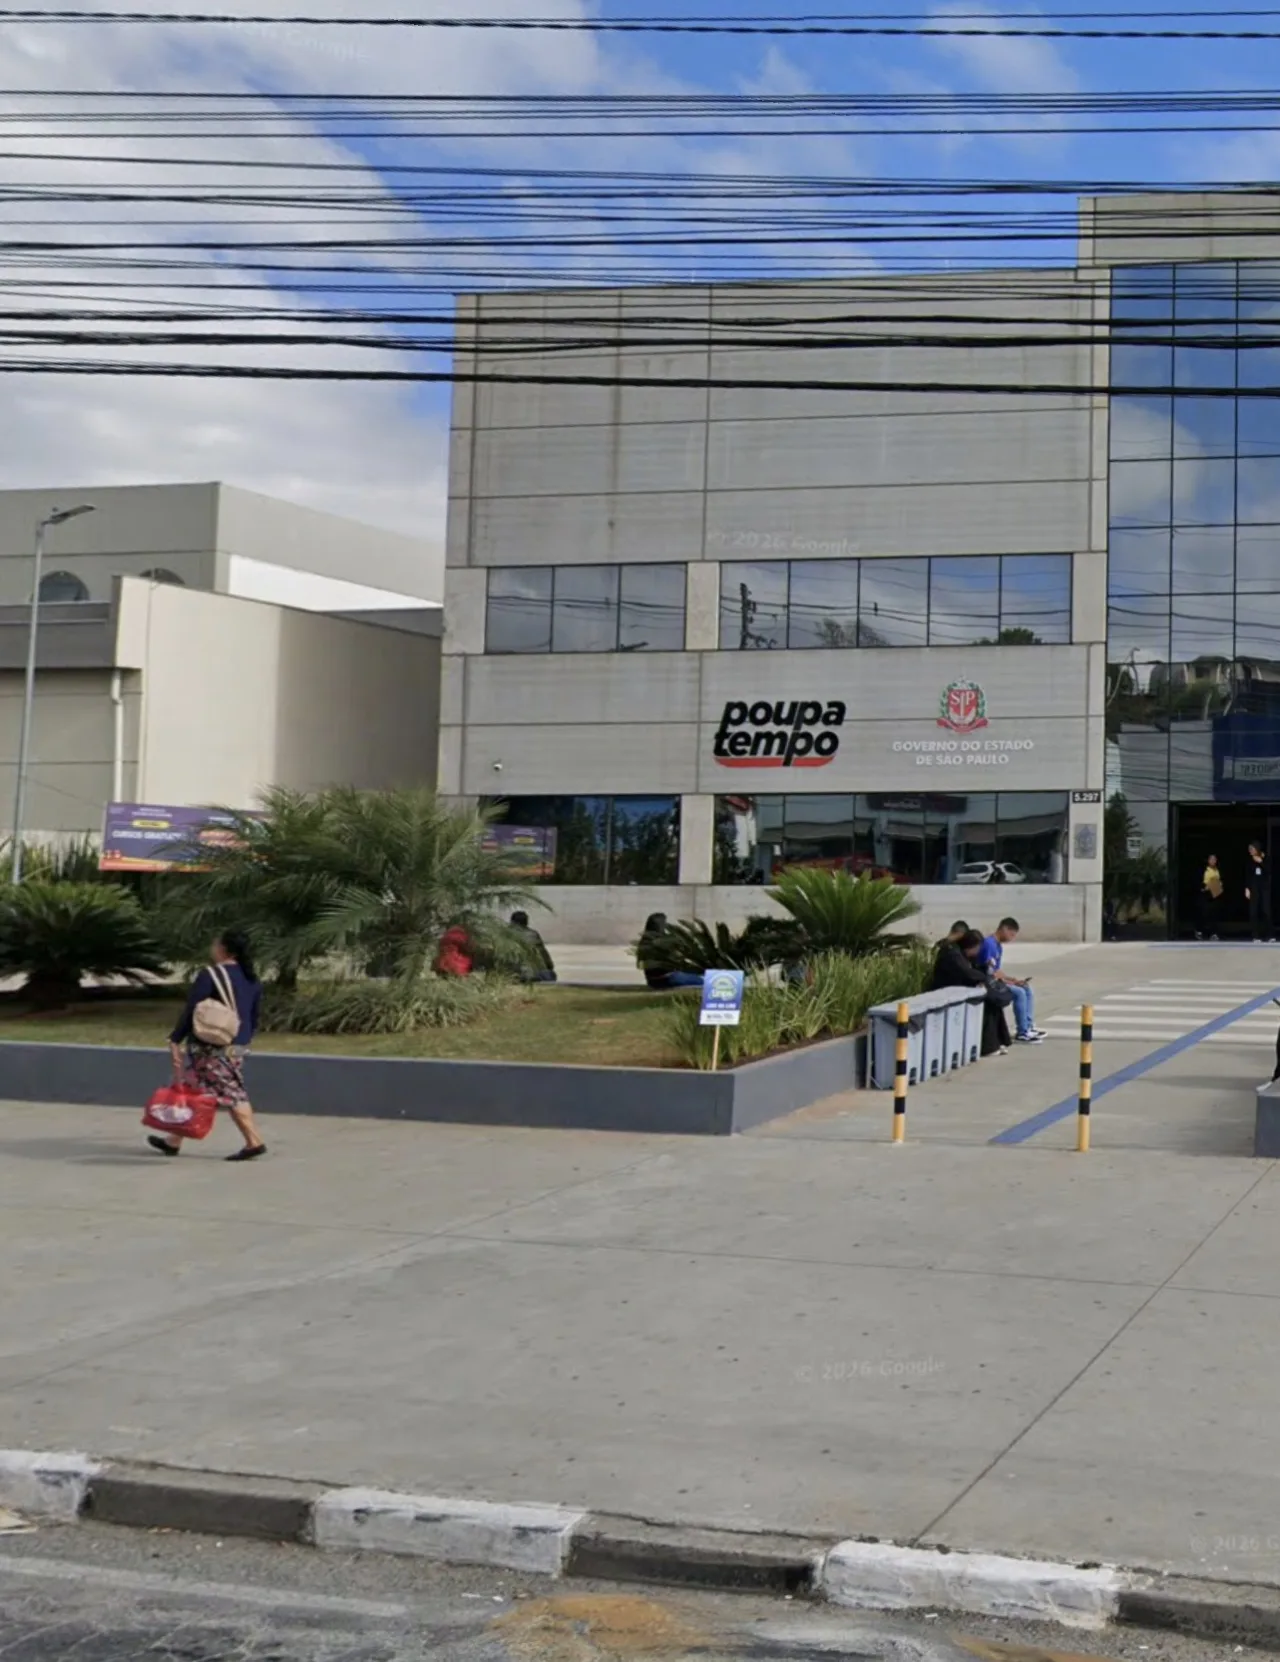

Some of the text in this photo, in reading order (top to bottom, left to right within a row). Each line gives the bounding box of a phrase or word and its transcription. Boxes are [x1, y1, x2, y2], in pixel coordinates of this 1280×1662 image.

[718, 701, 847, 731] poupa
[713, 730, 840, 767] tempo
[892, 739, 1034, 751] GOVERNO DO ESTADO
[915, 755, 933, 765] DE
[966, 753, 1009, 765] PAULO
